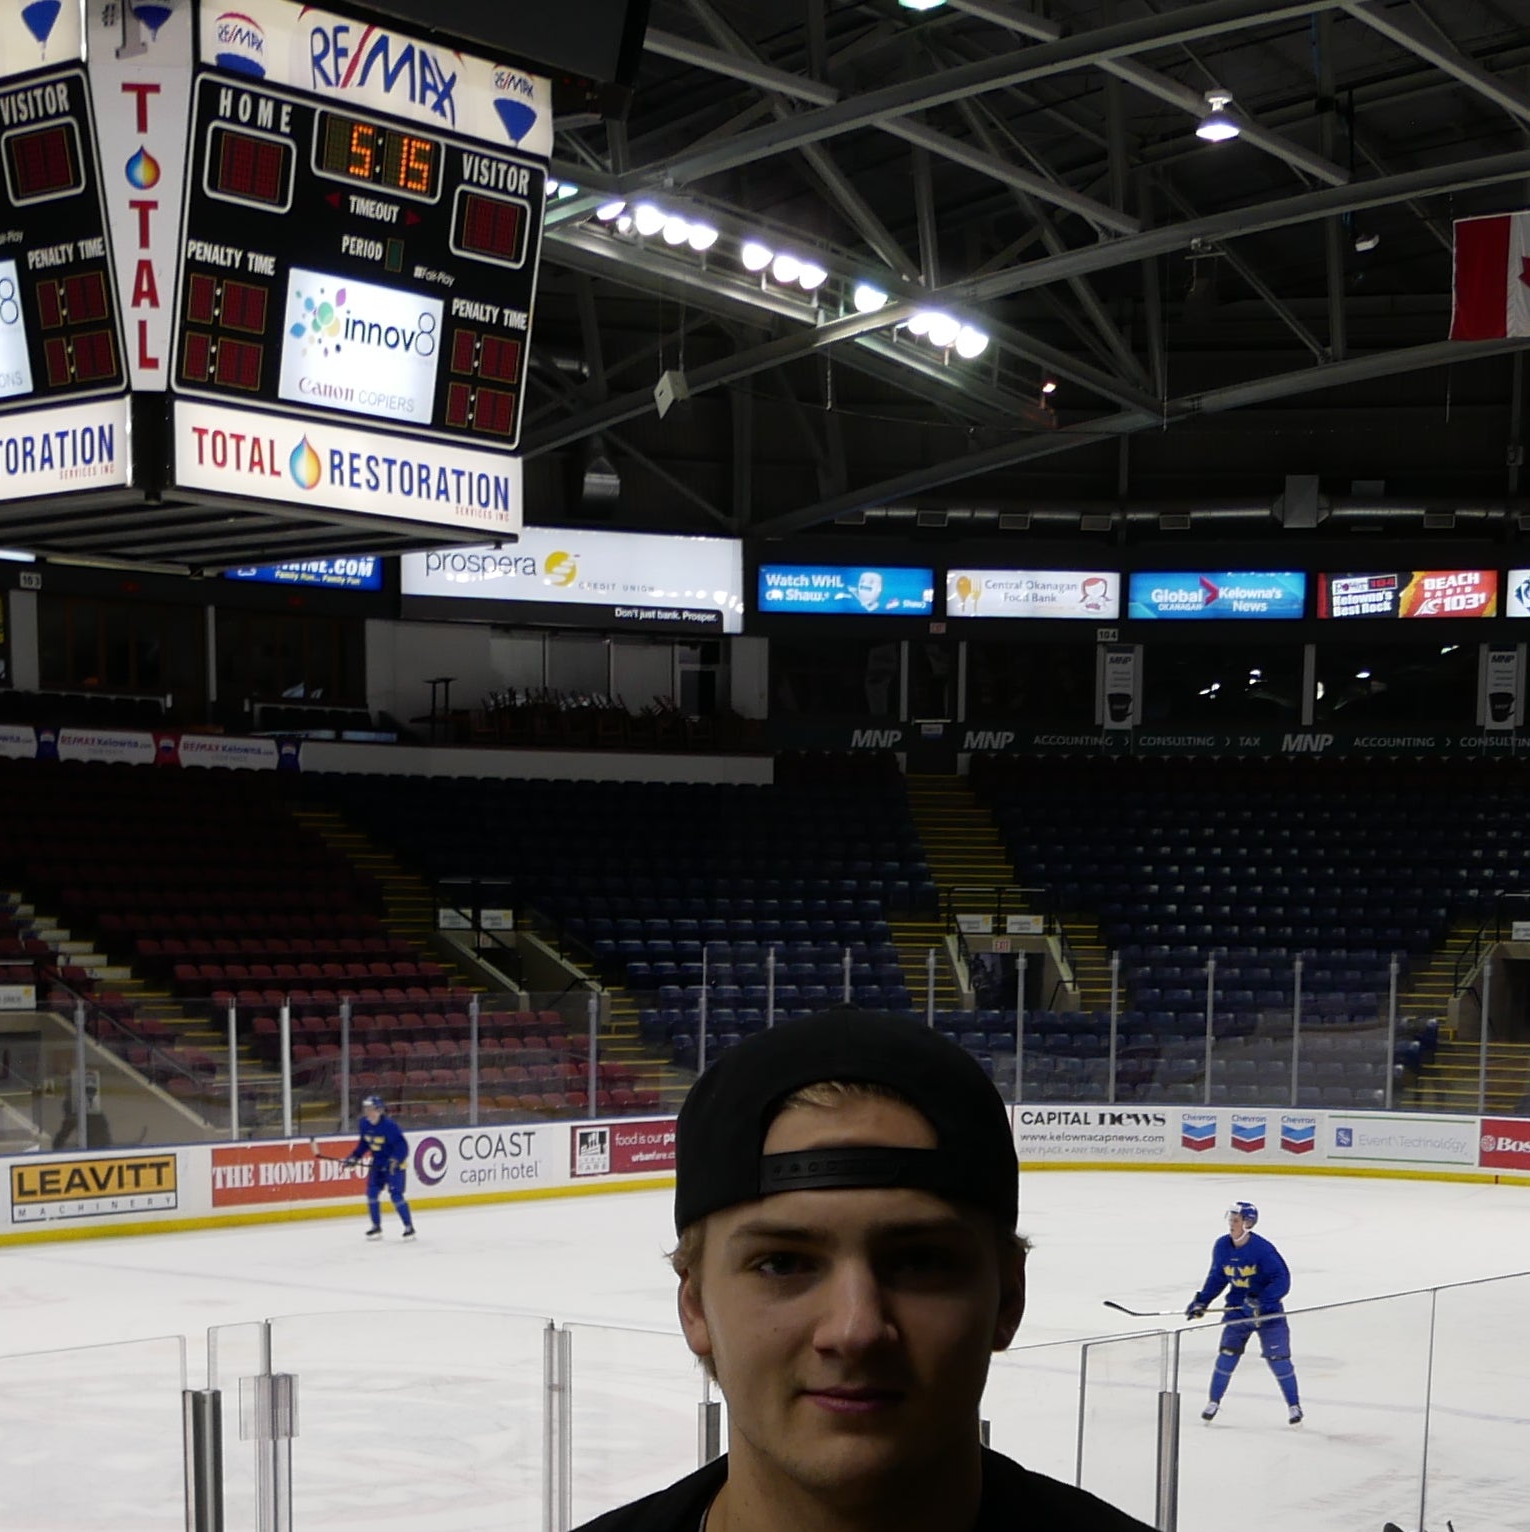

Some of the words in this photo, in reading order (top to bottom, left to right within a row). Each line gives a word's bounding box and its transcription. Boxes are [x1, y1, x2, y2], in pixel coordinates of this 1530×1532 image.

[217, 24, 263, 54] RE/MAX
[310, 24, 457, 129] RE/MAX
[0, 82, 70, 126] VISITOR
[219, 88, 292, 132] HOME
[462, 152, 530, 196] VISITOR
[349, 196, 399, 223] TIMEOUT
[27, 244, 74, 270] PENALTY
[77, 236, 106, 258] TIME
[187, 240, 242, 269] PENALTY
[247, 253, 276, 275] TIME
[342, 235, 382, 261] PERIOD
[452, 298, 499, 325] PENALTY
[502, 309, 529, 331] TIME
[299, 376, 355, 404] Canon
[358, 388, 415, 413] COPIERS
[192, 426, 282, 477] TOTAL
[329, 448, 510, 512] RESTORATION
[425, 550, 537, 577] prospera
[765, 574, 809, 588] Watch
[811, 575, 844, 588] WHL
[985, 578, 1023, 592] Central
[1026, 579, 1078, 595] Okanagan
[1424, 573, 1480, 590] BEACH
[1030, 592, 1058, 604] Bank
[1151, 588, 1203, 604] Global
[1219, 586, 1282, 600] Kelowna's
[614, 606, 638, 619] Don't
[638, 608, 656, 621] just
[657, 609, 681, 622] bank.
[682, 610, 719, 624] Prosper.
[1232, 600, 1267, 612] News
[1098, 630, 1118, 641] 104
[851, 728, 903, 748] MNP
[963, 730, 1015, 750] MNP
[1032, 734, 1114, 747] ACCOUNTING
[1138, 735, 1215, 748] CONSULTING
[1238, 736, 1261, 748] TAX
[1281, 732, 1335, 753] MNP
[1353, 735, 1436, 749] ACCOUNTING
[1020, 1111, 1091, 1127] CAPITAL
[1098, 1111, 1166, 1128] news
[1182, 1112, 1217, 1123] Chevron
[1232, 1114, 1267, 1124] Chevron
[1280, 1115, 1316, 1125] Chevron
[459, 1131, 536, 1161] COAST
[615, 1131, 637, 1146] food
[1020, 1131, 1166, 1144] www.kelownacapnews.com
[17, 1160, 171, 1198] LEAVITT
[212, 1163, 255, 1190] THE
[259, 1159, 315, 1188] HOME
[459, 1165, 497, 1187] capri
[500, 1162, 540, 1182] hotel
[18, 1196, 174, 1218] MACHINERY
